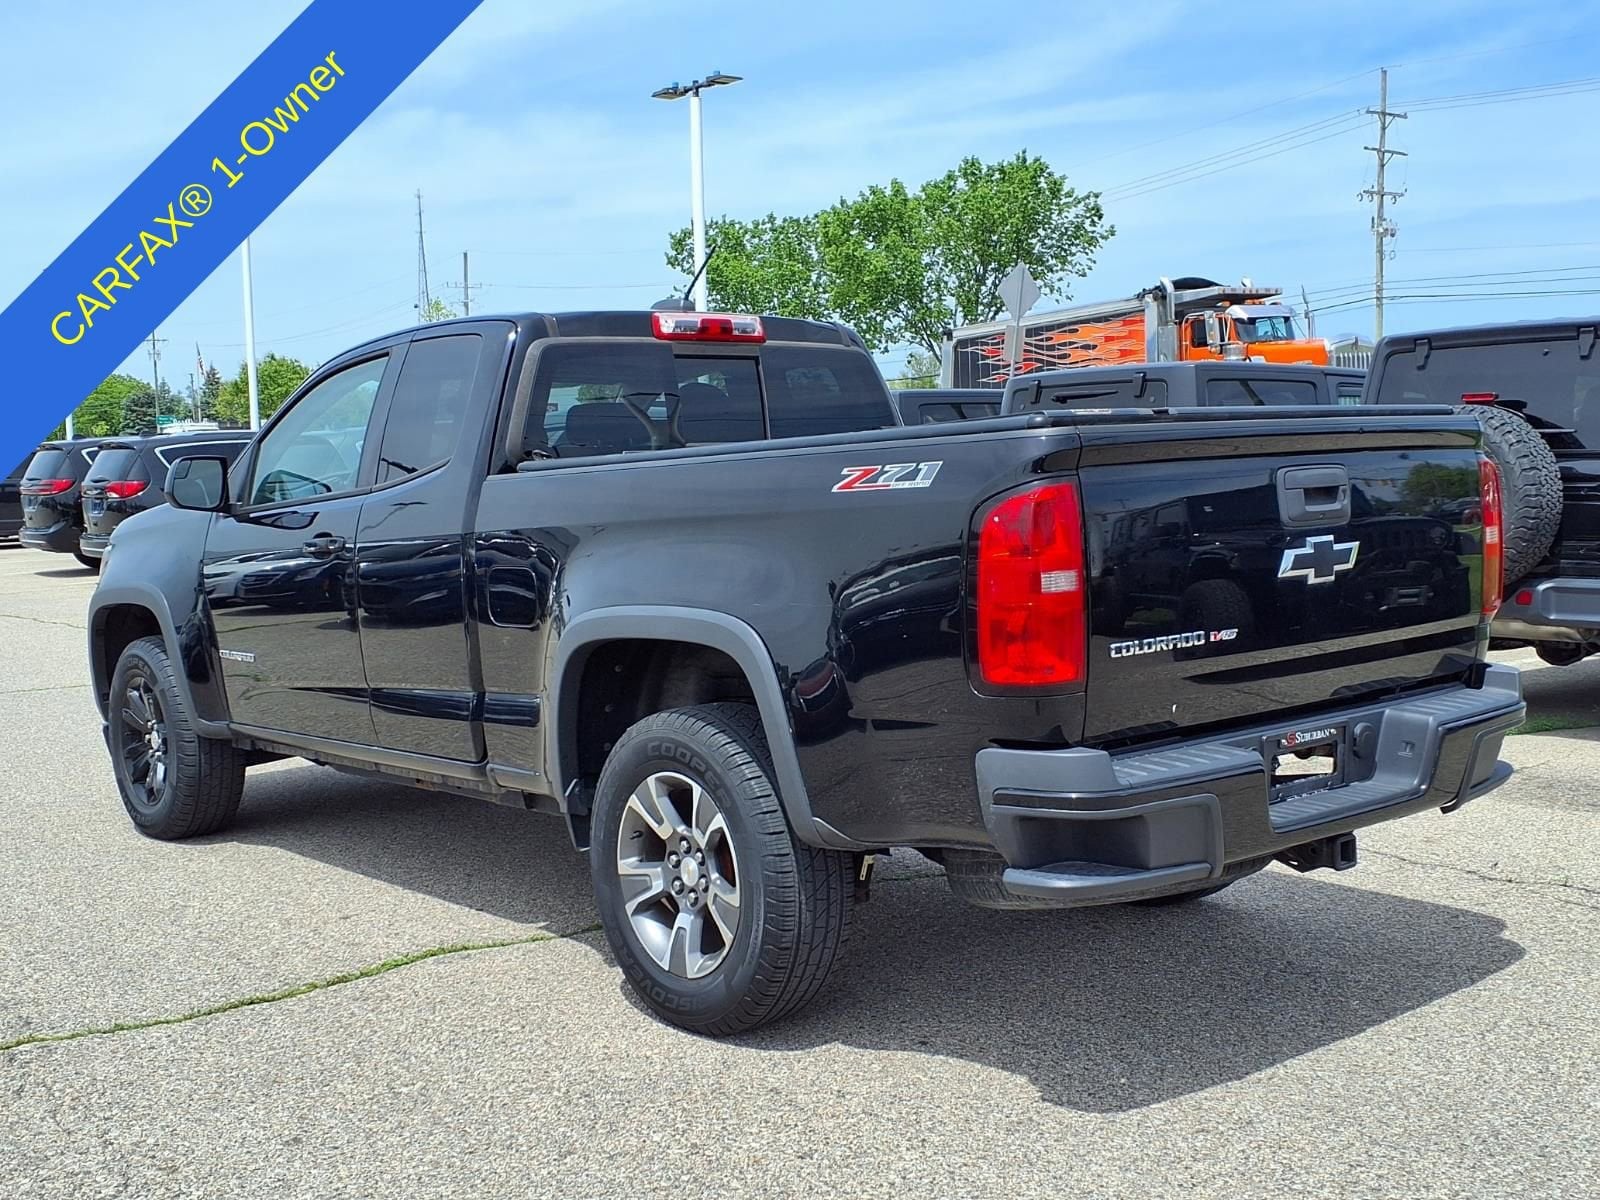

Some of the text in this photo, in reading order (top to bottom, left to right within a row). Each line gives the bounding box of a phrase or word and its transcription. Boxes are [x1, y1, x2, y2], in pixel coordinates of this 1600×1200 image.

[831, 460, 944, 492] Z71
[1110, 631, 1205, 658] COLORADO
[647, 741, 732, 808] COOPER
